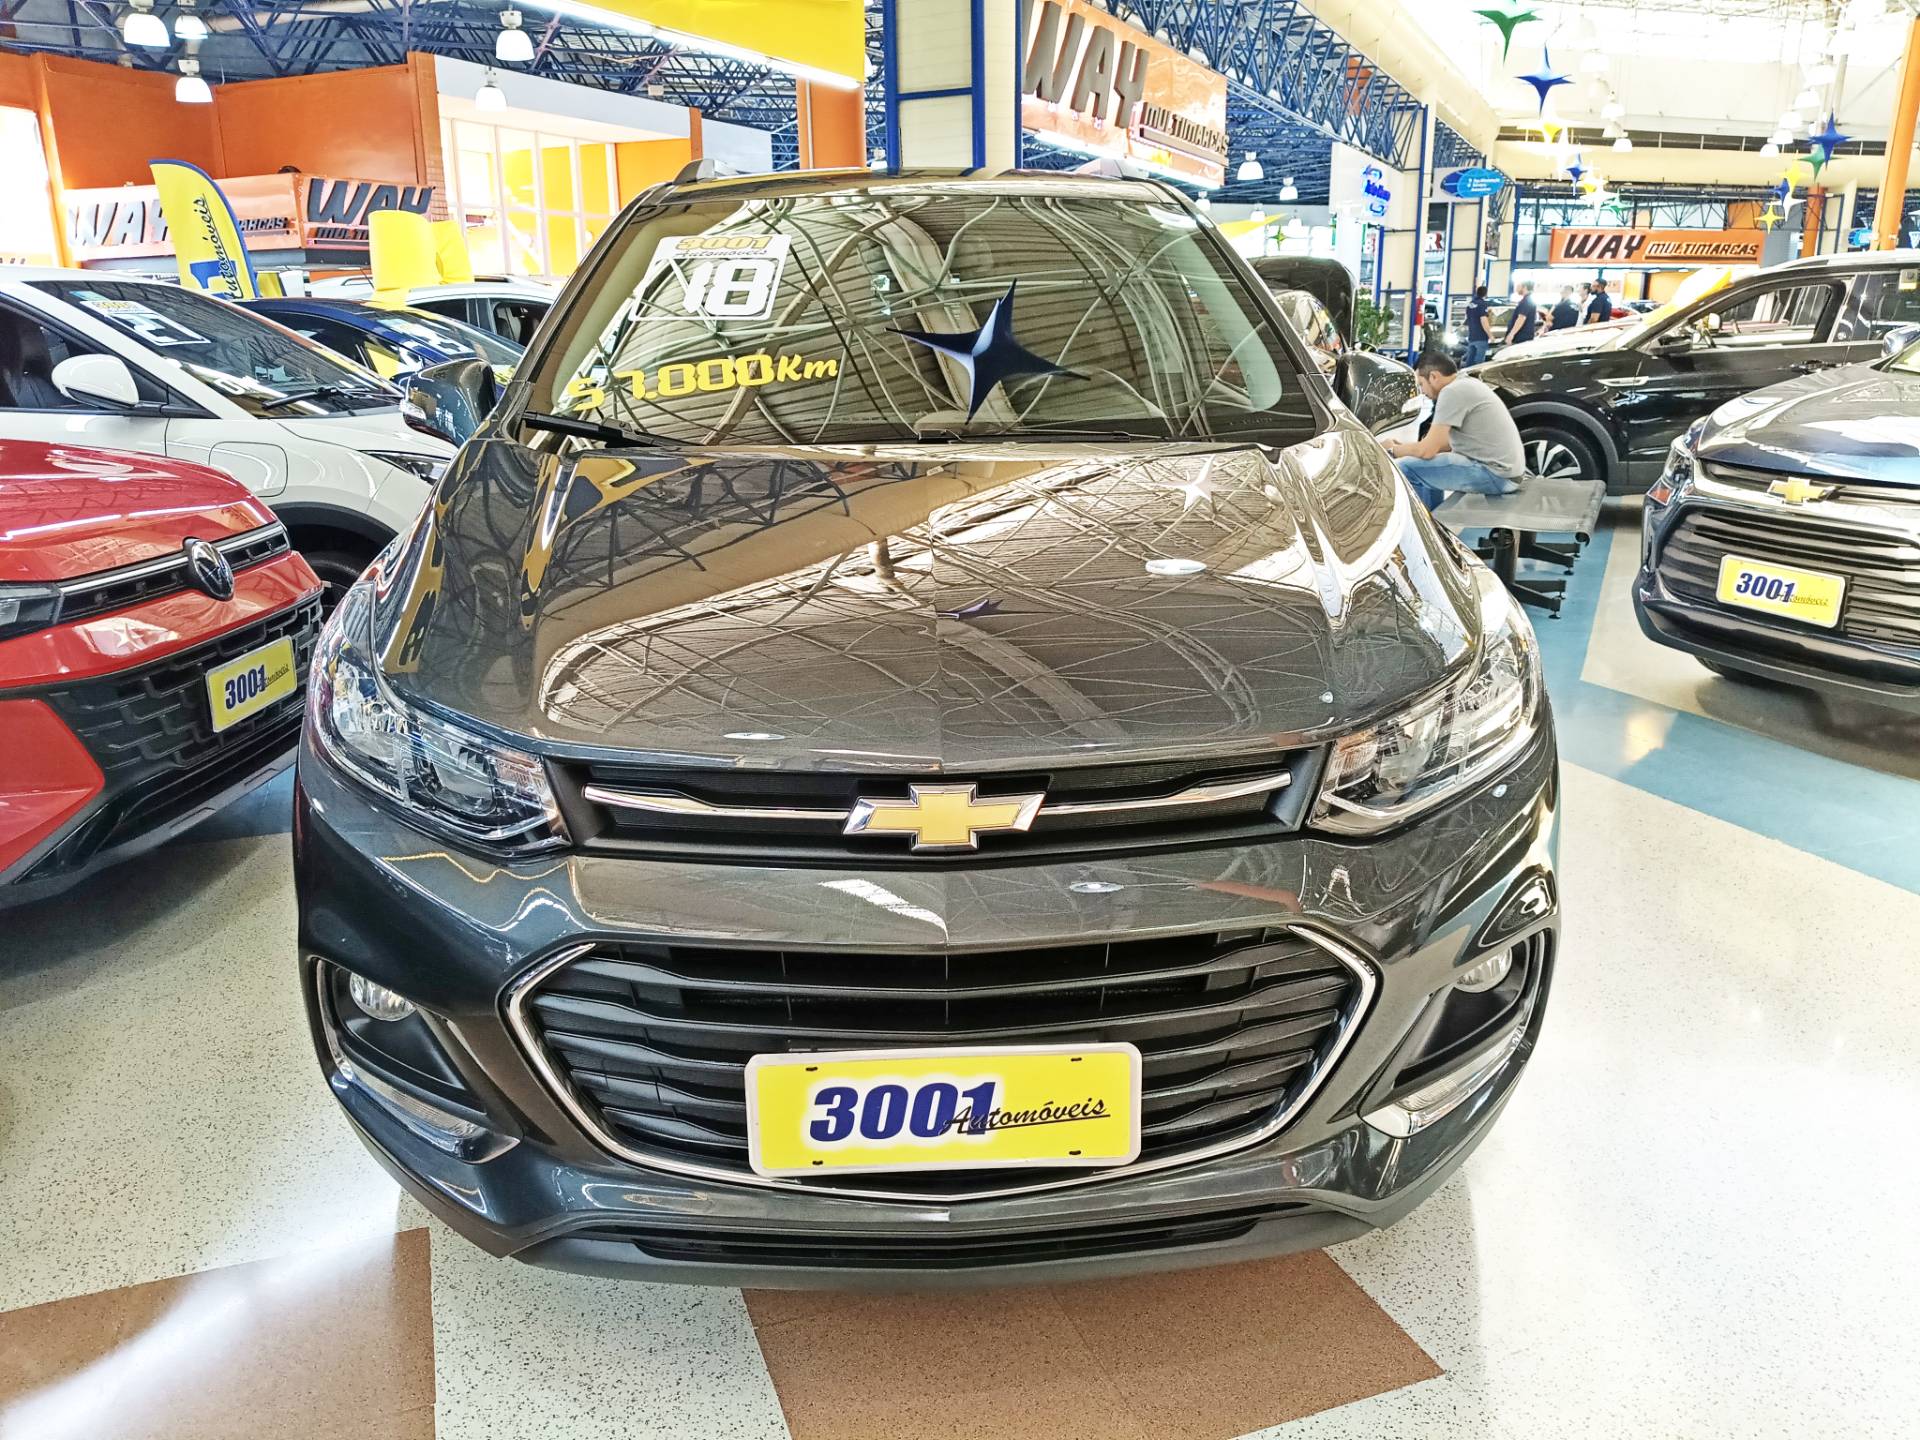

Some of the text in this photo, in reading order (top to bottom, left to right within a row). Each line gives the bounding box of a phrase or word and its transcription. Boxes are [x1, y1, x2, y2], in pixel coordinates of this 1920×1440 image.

[675, 236, 773, 250] 3001
[1563, 234, 1760, 259] WAY MULTIMARCAS
[682, 260, 777, 316] 18
[1736, 573, 1796, 603] 3001
[225, 664, 266, 710] 3001
[809, 1081, 1108, 1142] 3001 Automóveis
